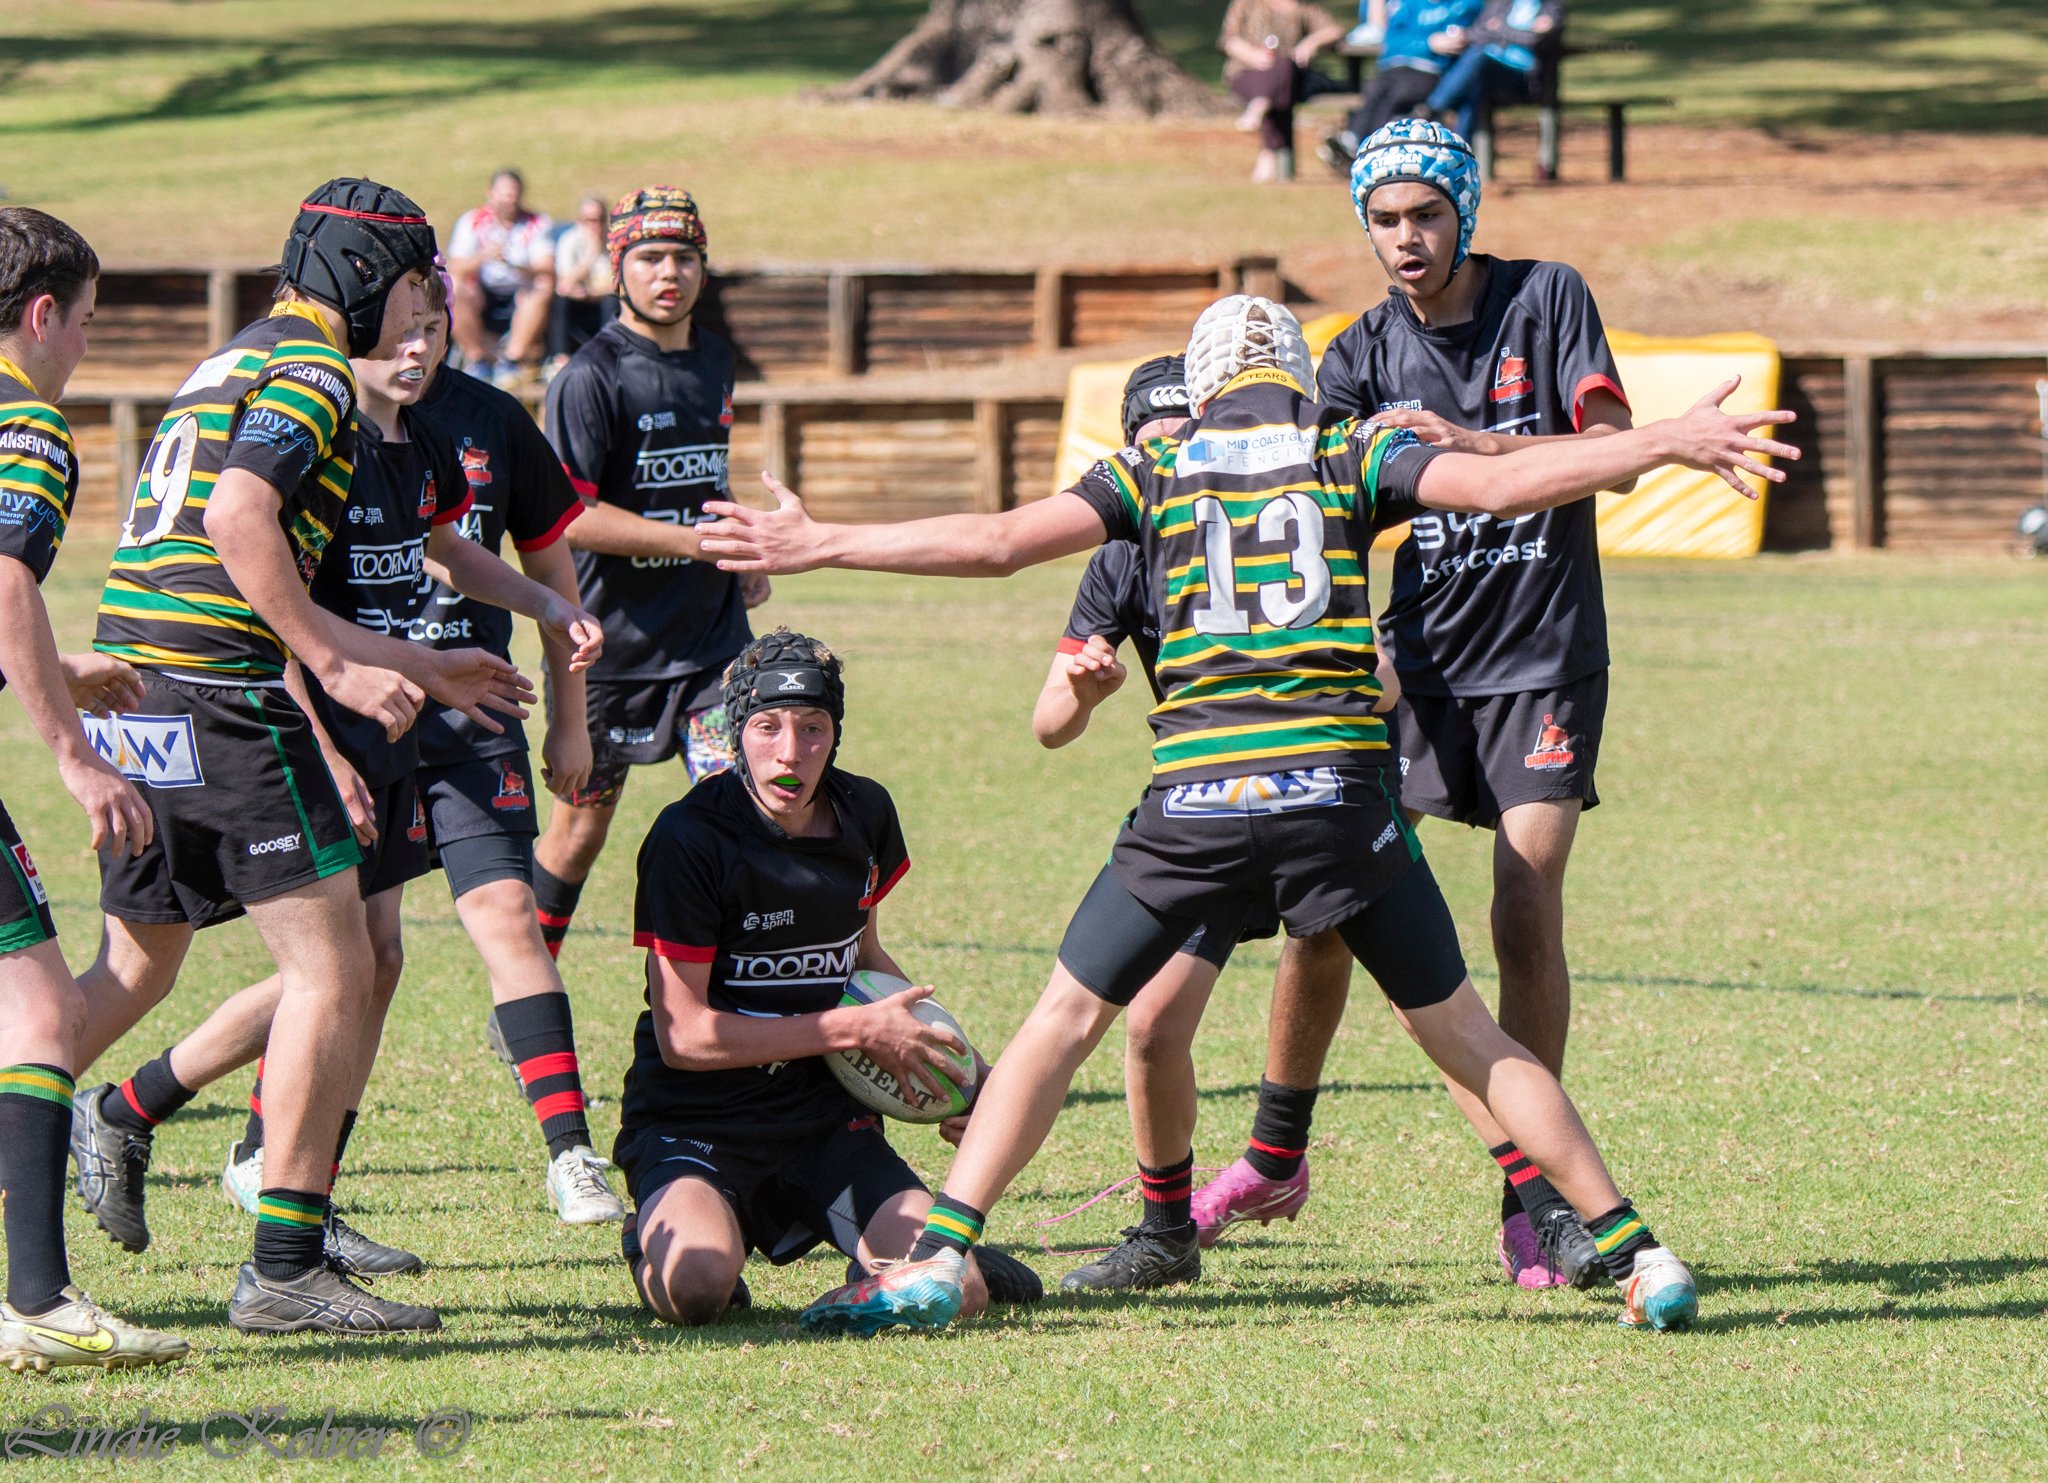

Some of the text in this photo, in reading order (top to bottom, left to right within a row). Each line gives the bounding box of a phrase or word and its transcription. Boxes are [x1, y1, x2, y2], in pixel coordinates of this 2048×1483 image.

[1248, 372, 1287, 382] YEARS
[1227, 439, 1248, 450] MID
[1252, 434, 1286, 449] COAST
[1193, 491, 1331, 637] 13
[1467, 536, 1548, 570] Coast
[249, 832, 301, 856] GOOSEY
